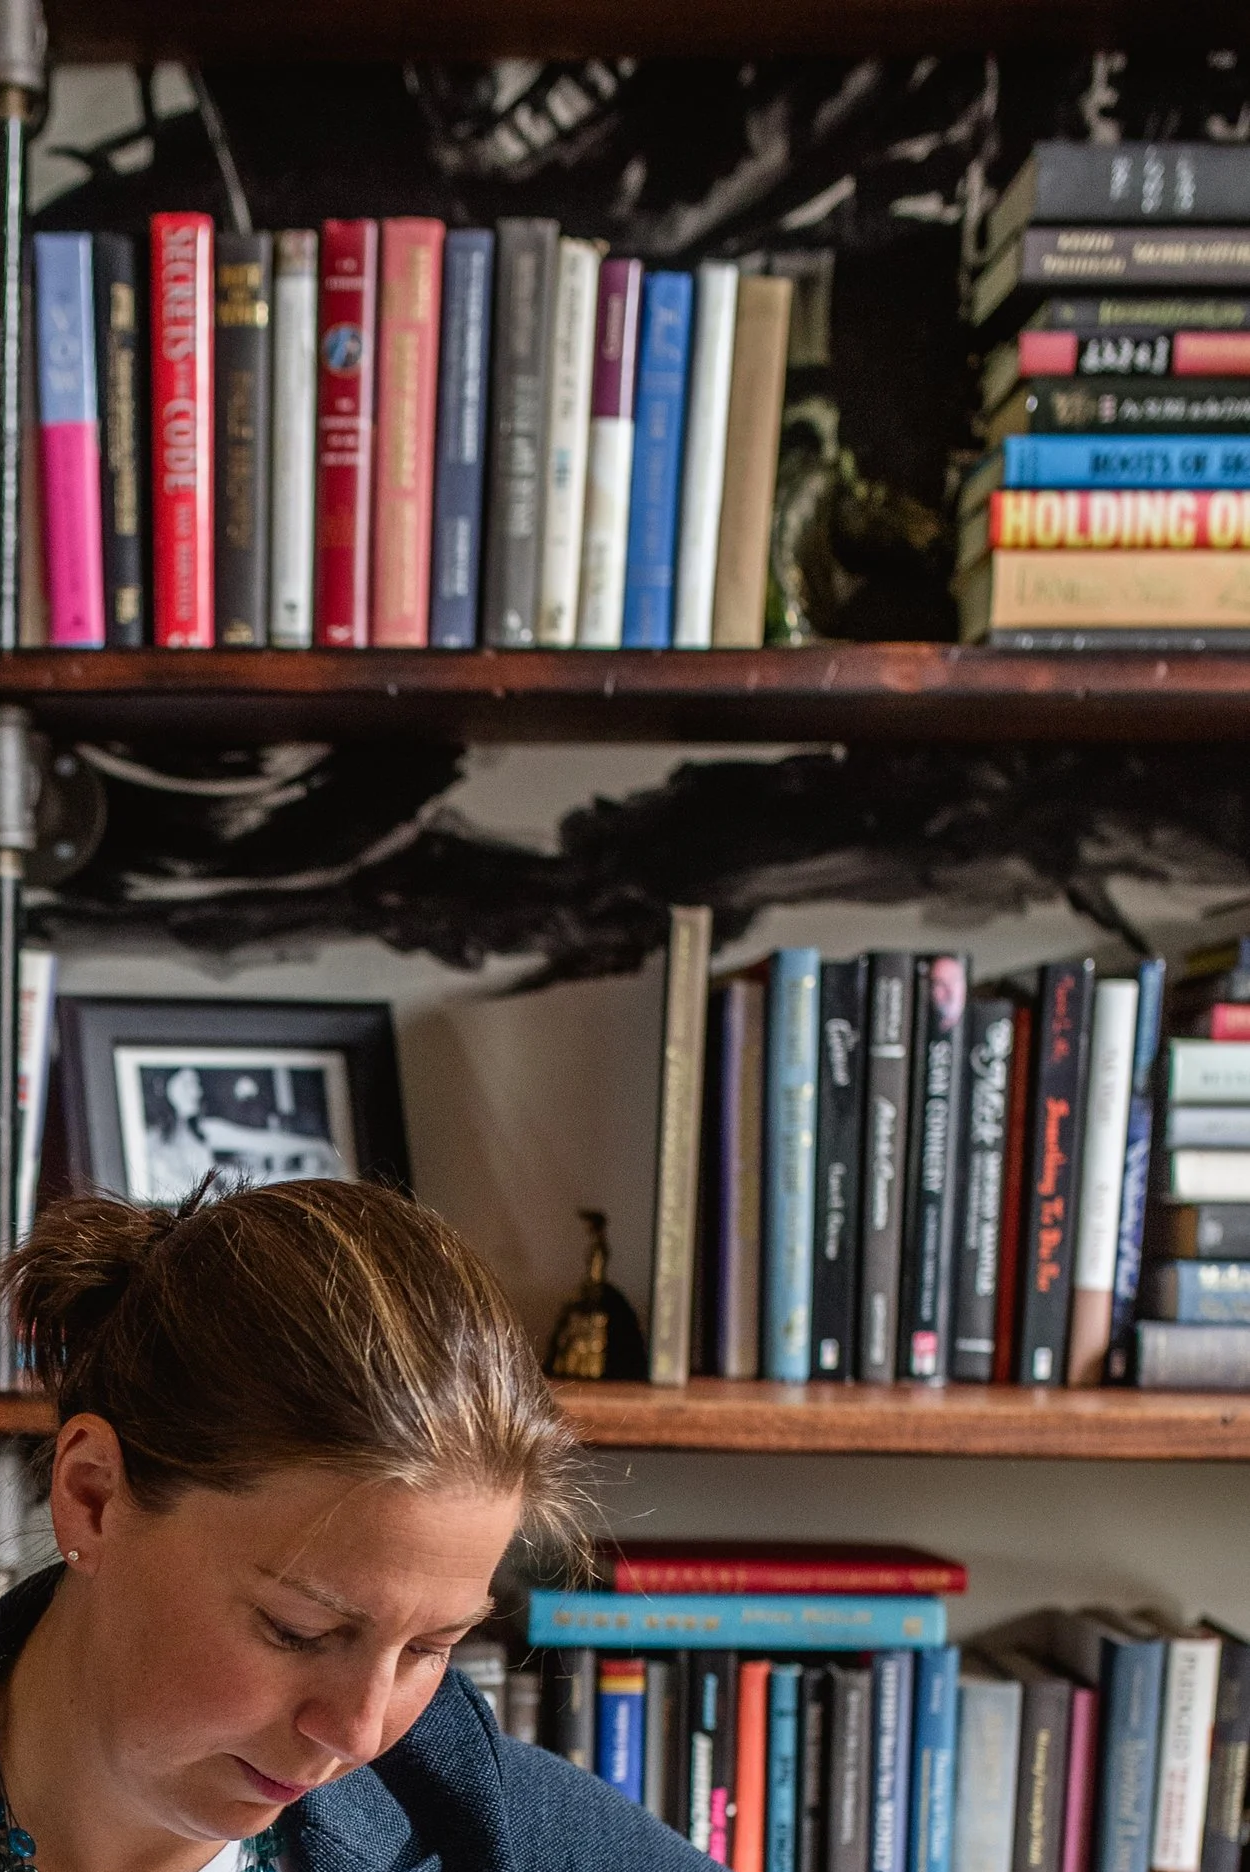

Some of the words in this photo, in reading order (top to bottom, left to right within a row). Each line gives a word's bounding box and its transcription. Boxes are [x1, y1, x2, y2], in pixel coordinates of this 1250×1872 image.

[164, 223, 198, 363] SECRETS
[164, 398, 199, 495] CODE
[1001, 490, 1197, 549] HOLDING
[923, 1100, 948, 1193] CONNERY
